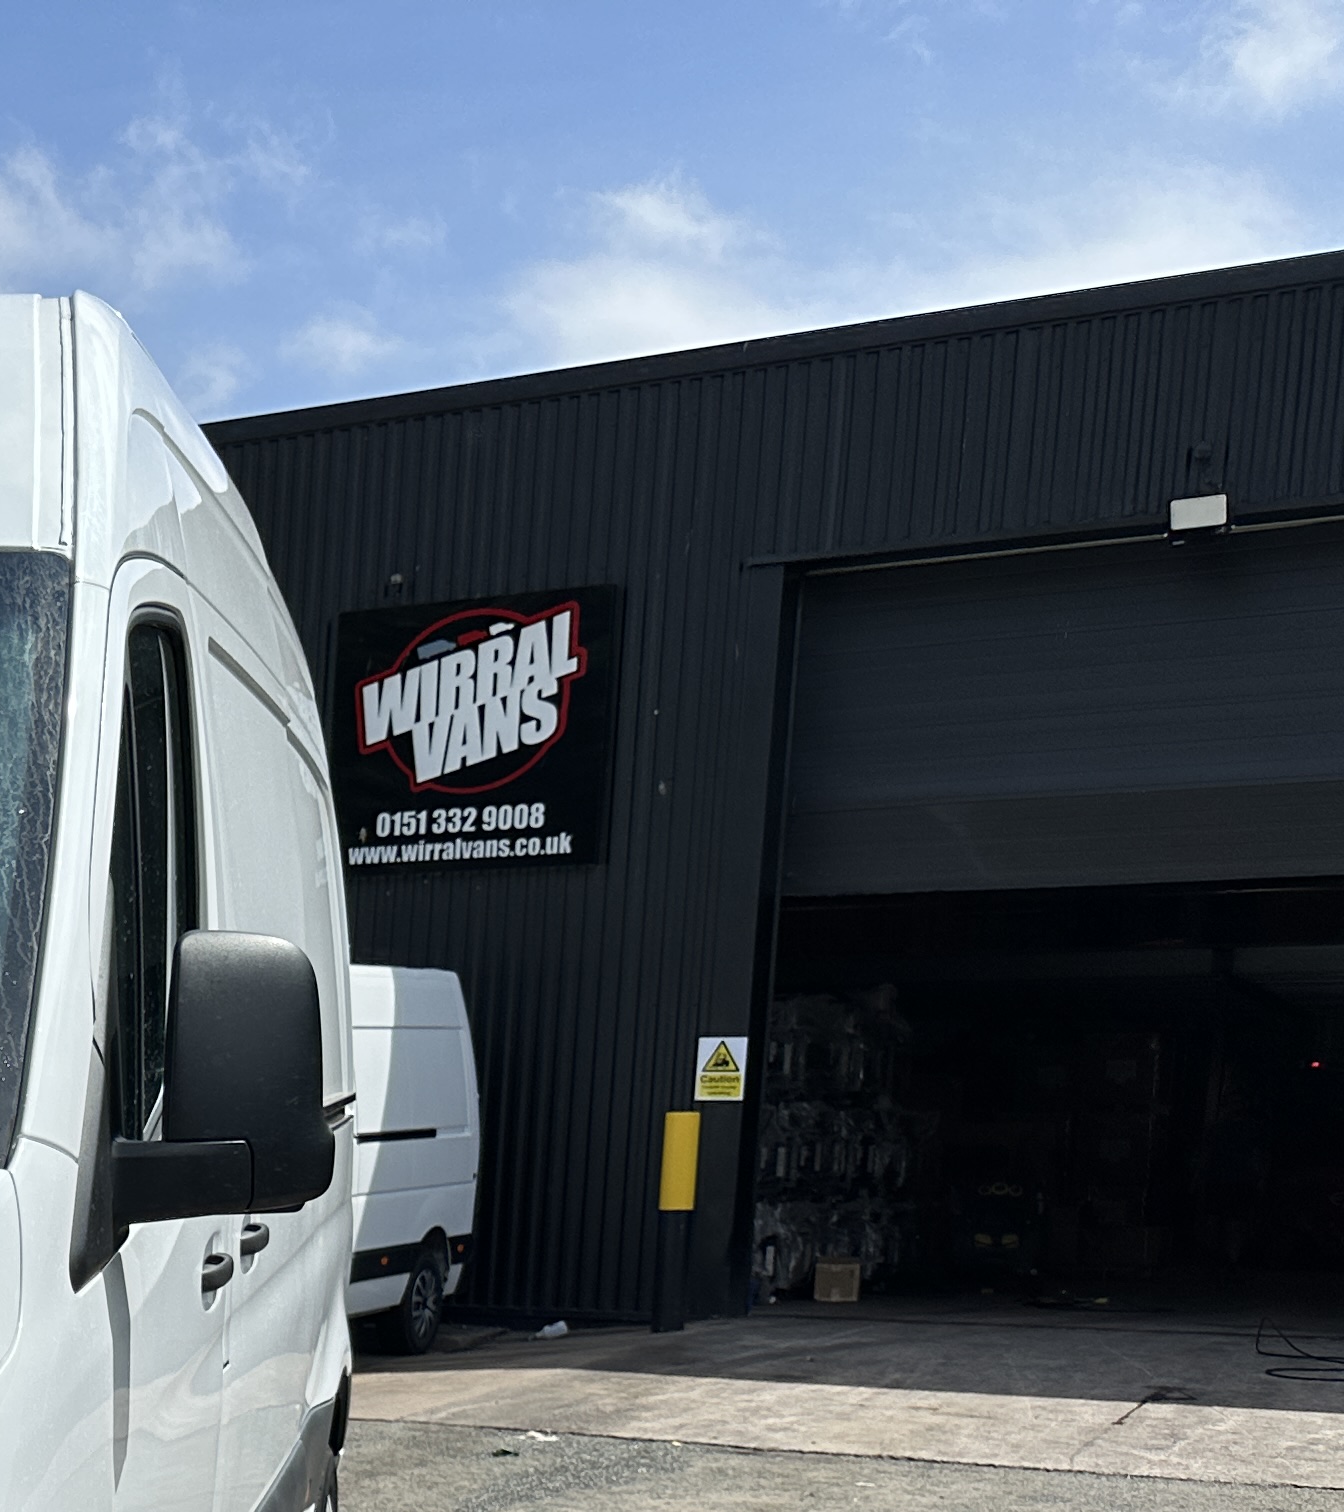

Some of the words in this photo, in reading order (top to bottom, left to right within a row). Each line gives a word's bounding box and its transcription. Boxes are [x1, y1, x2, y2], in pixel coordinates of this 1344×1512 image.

[362, 610, 578, 746] WIRRAL
[412, 678, 559, 784] VANS
[348, 831, 573, 866] www.wirralvans.co.uk
[376, 809, 428, 838] 0151
[432, 807, 477, 835] 332
[482, 802, 546, 830] 9008
